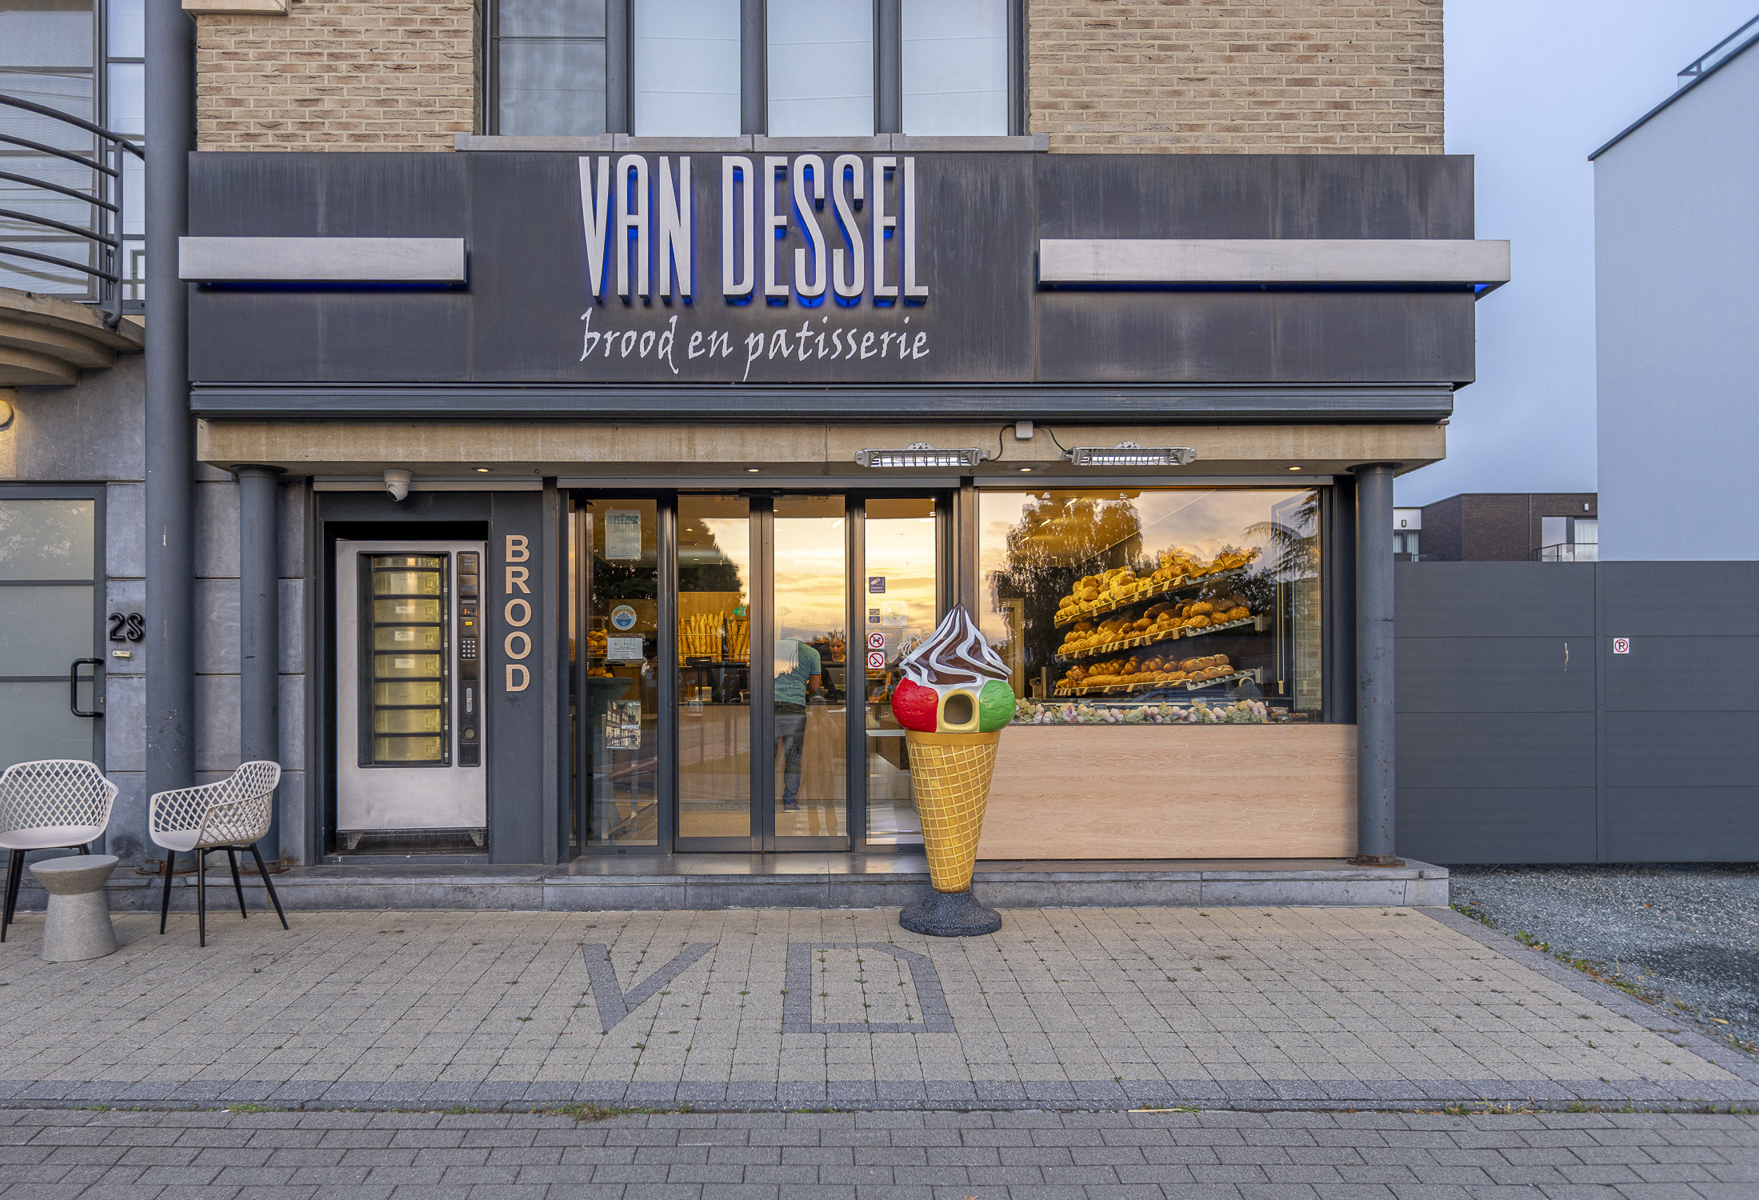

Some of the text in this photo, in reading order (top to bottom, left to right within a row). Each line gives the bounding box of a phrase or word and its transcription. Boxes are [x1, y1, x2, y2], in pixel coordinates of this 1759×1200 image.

[578, 153, 930, 299] VAN DESSEL
[579, 306, 931, 382] brood en patisserie
[108, 611, 144, 642] 28
[504, 534, 532, 693] BROOD
